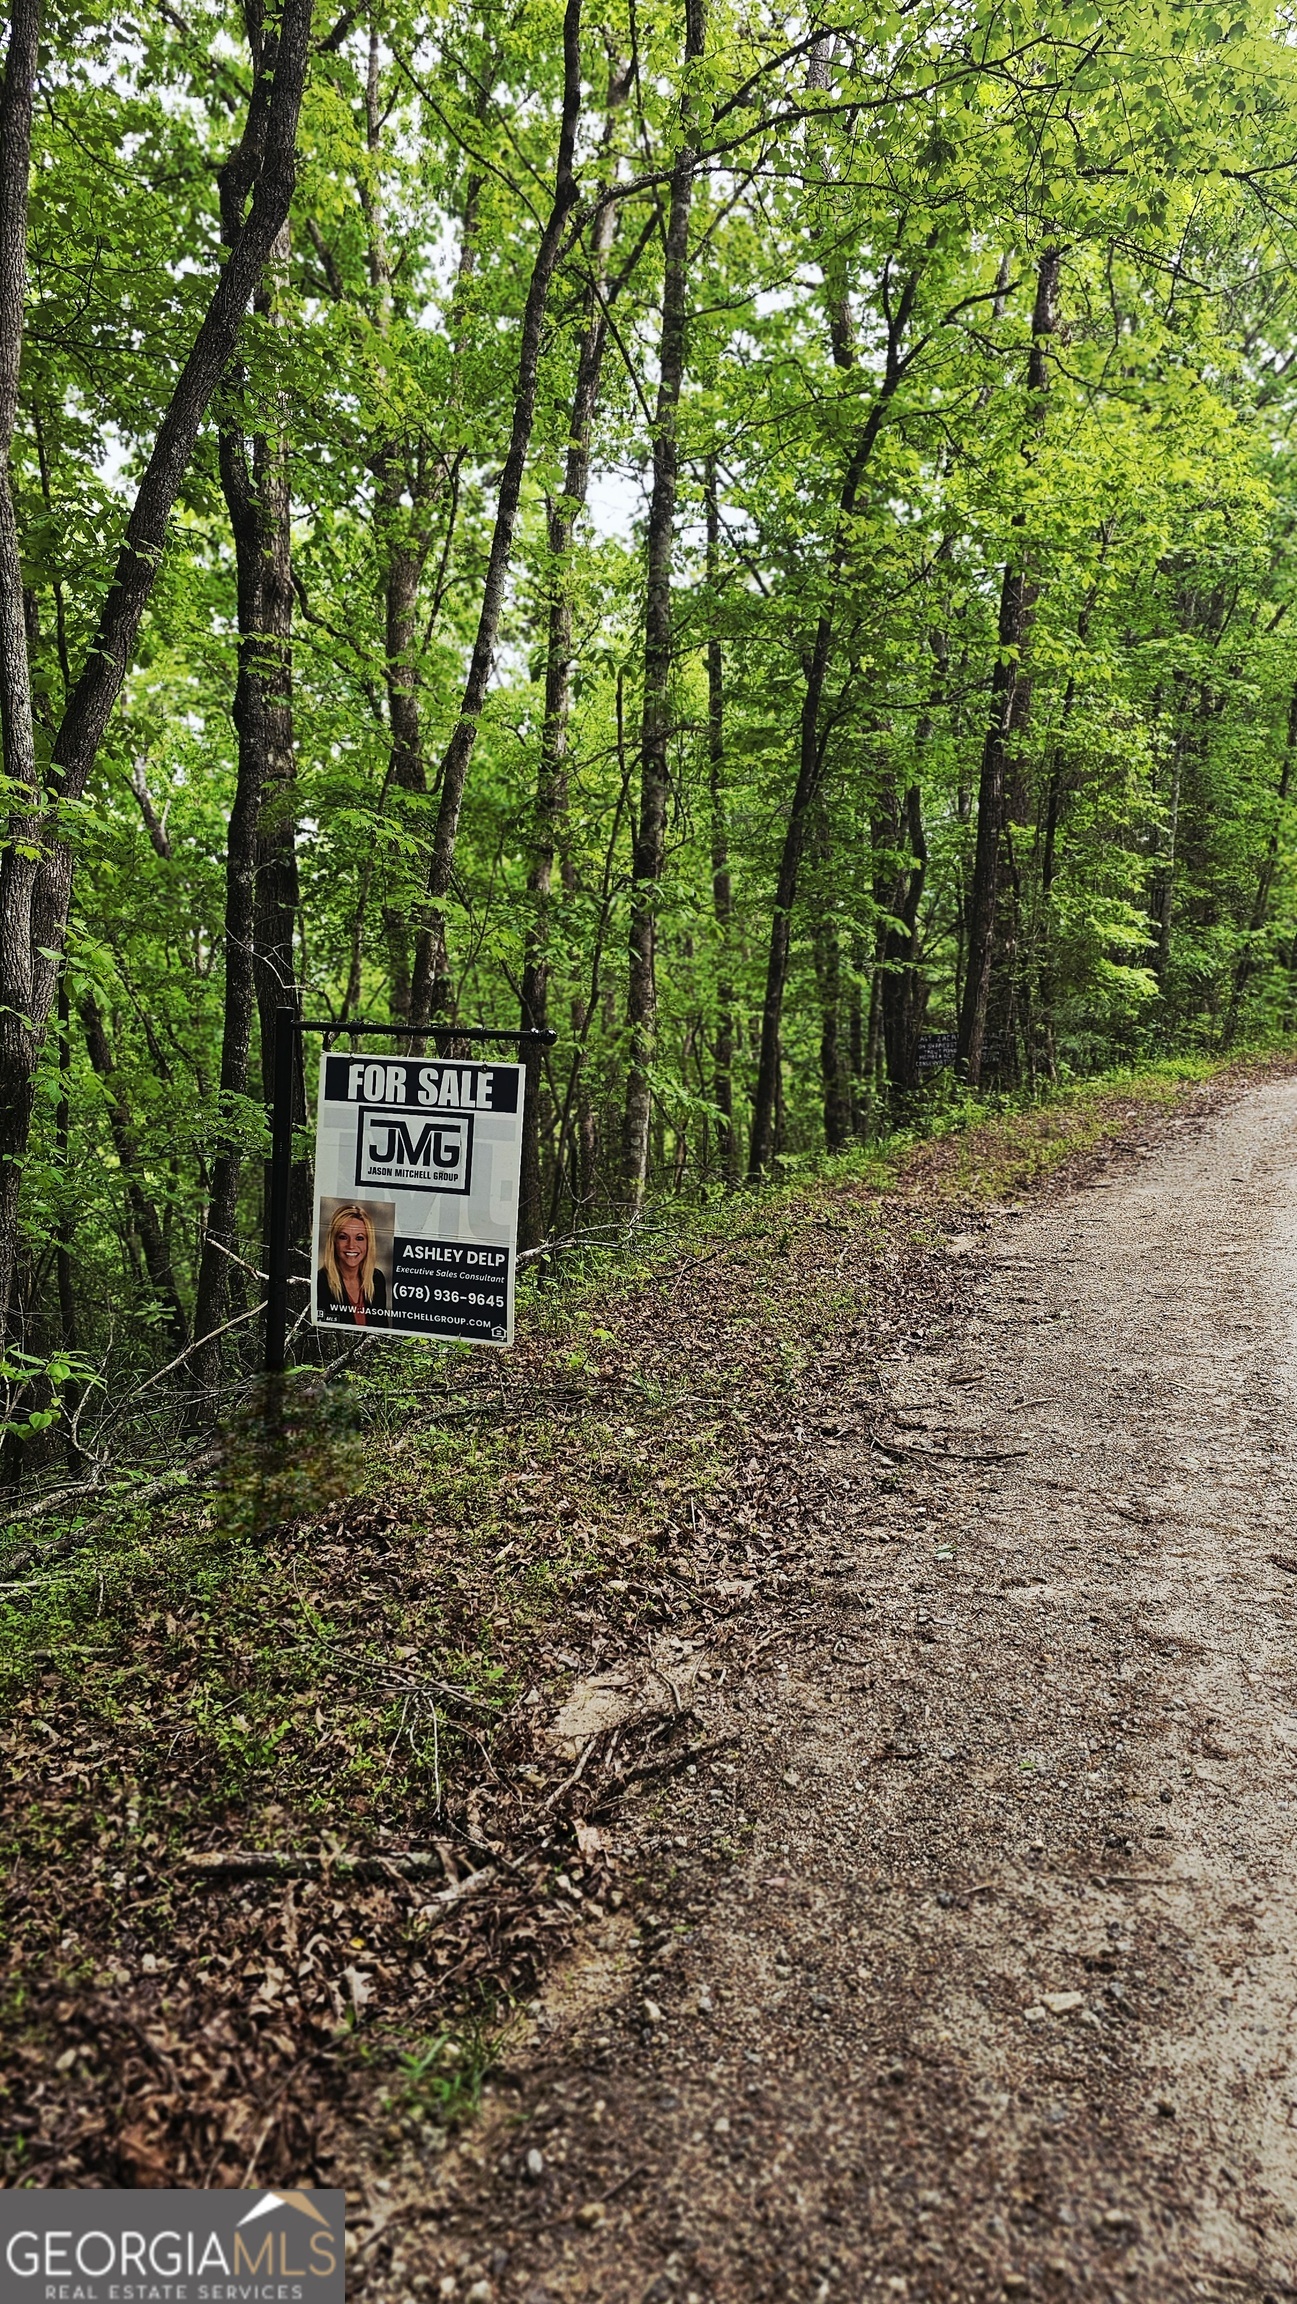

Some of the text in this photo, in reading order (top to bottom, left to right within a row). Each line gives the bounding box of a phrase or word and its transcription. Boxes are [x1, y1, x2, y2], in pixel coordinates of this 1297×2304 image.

[347, 1063, 494, 1109] FOR SALE
[369, 1118, 461, 1168] JMG
[367, 1166, 459, 1182] JASON MITCHELL GROUP
[402, 1244, 506, 1267] ASHLEY DELP
[395, 1265, 505, 1284] Executive Sales Consultant
[392, 1282, 504, 1308] (678) 936-9645
[329, 1303, 491, 1328] WWW.JASONMITCHELLGROUP.COM
